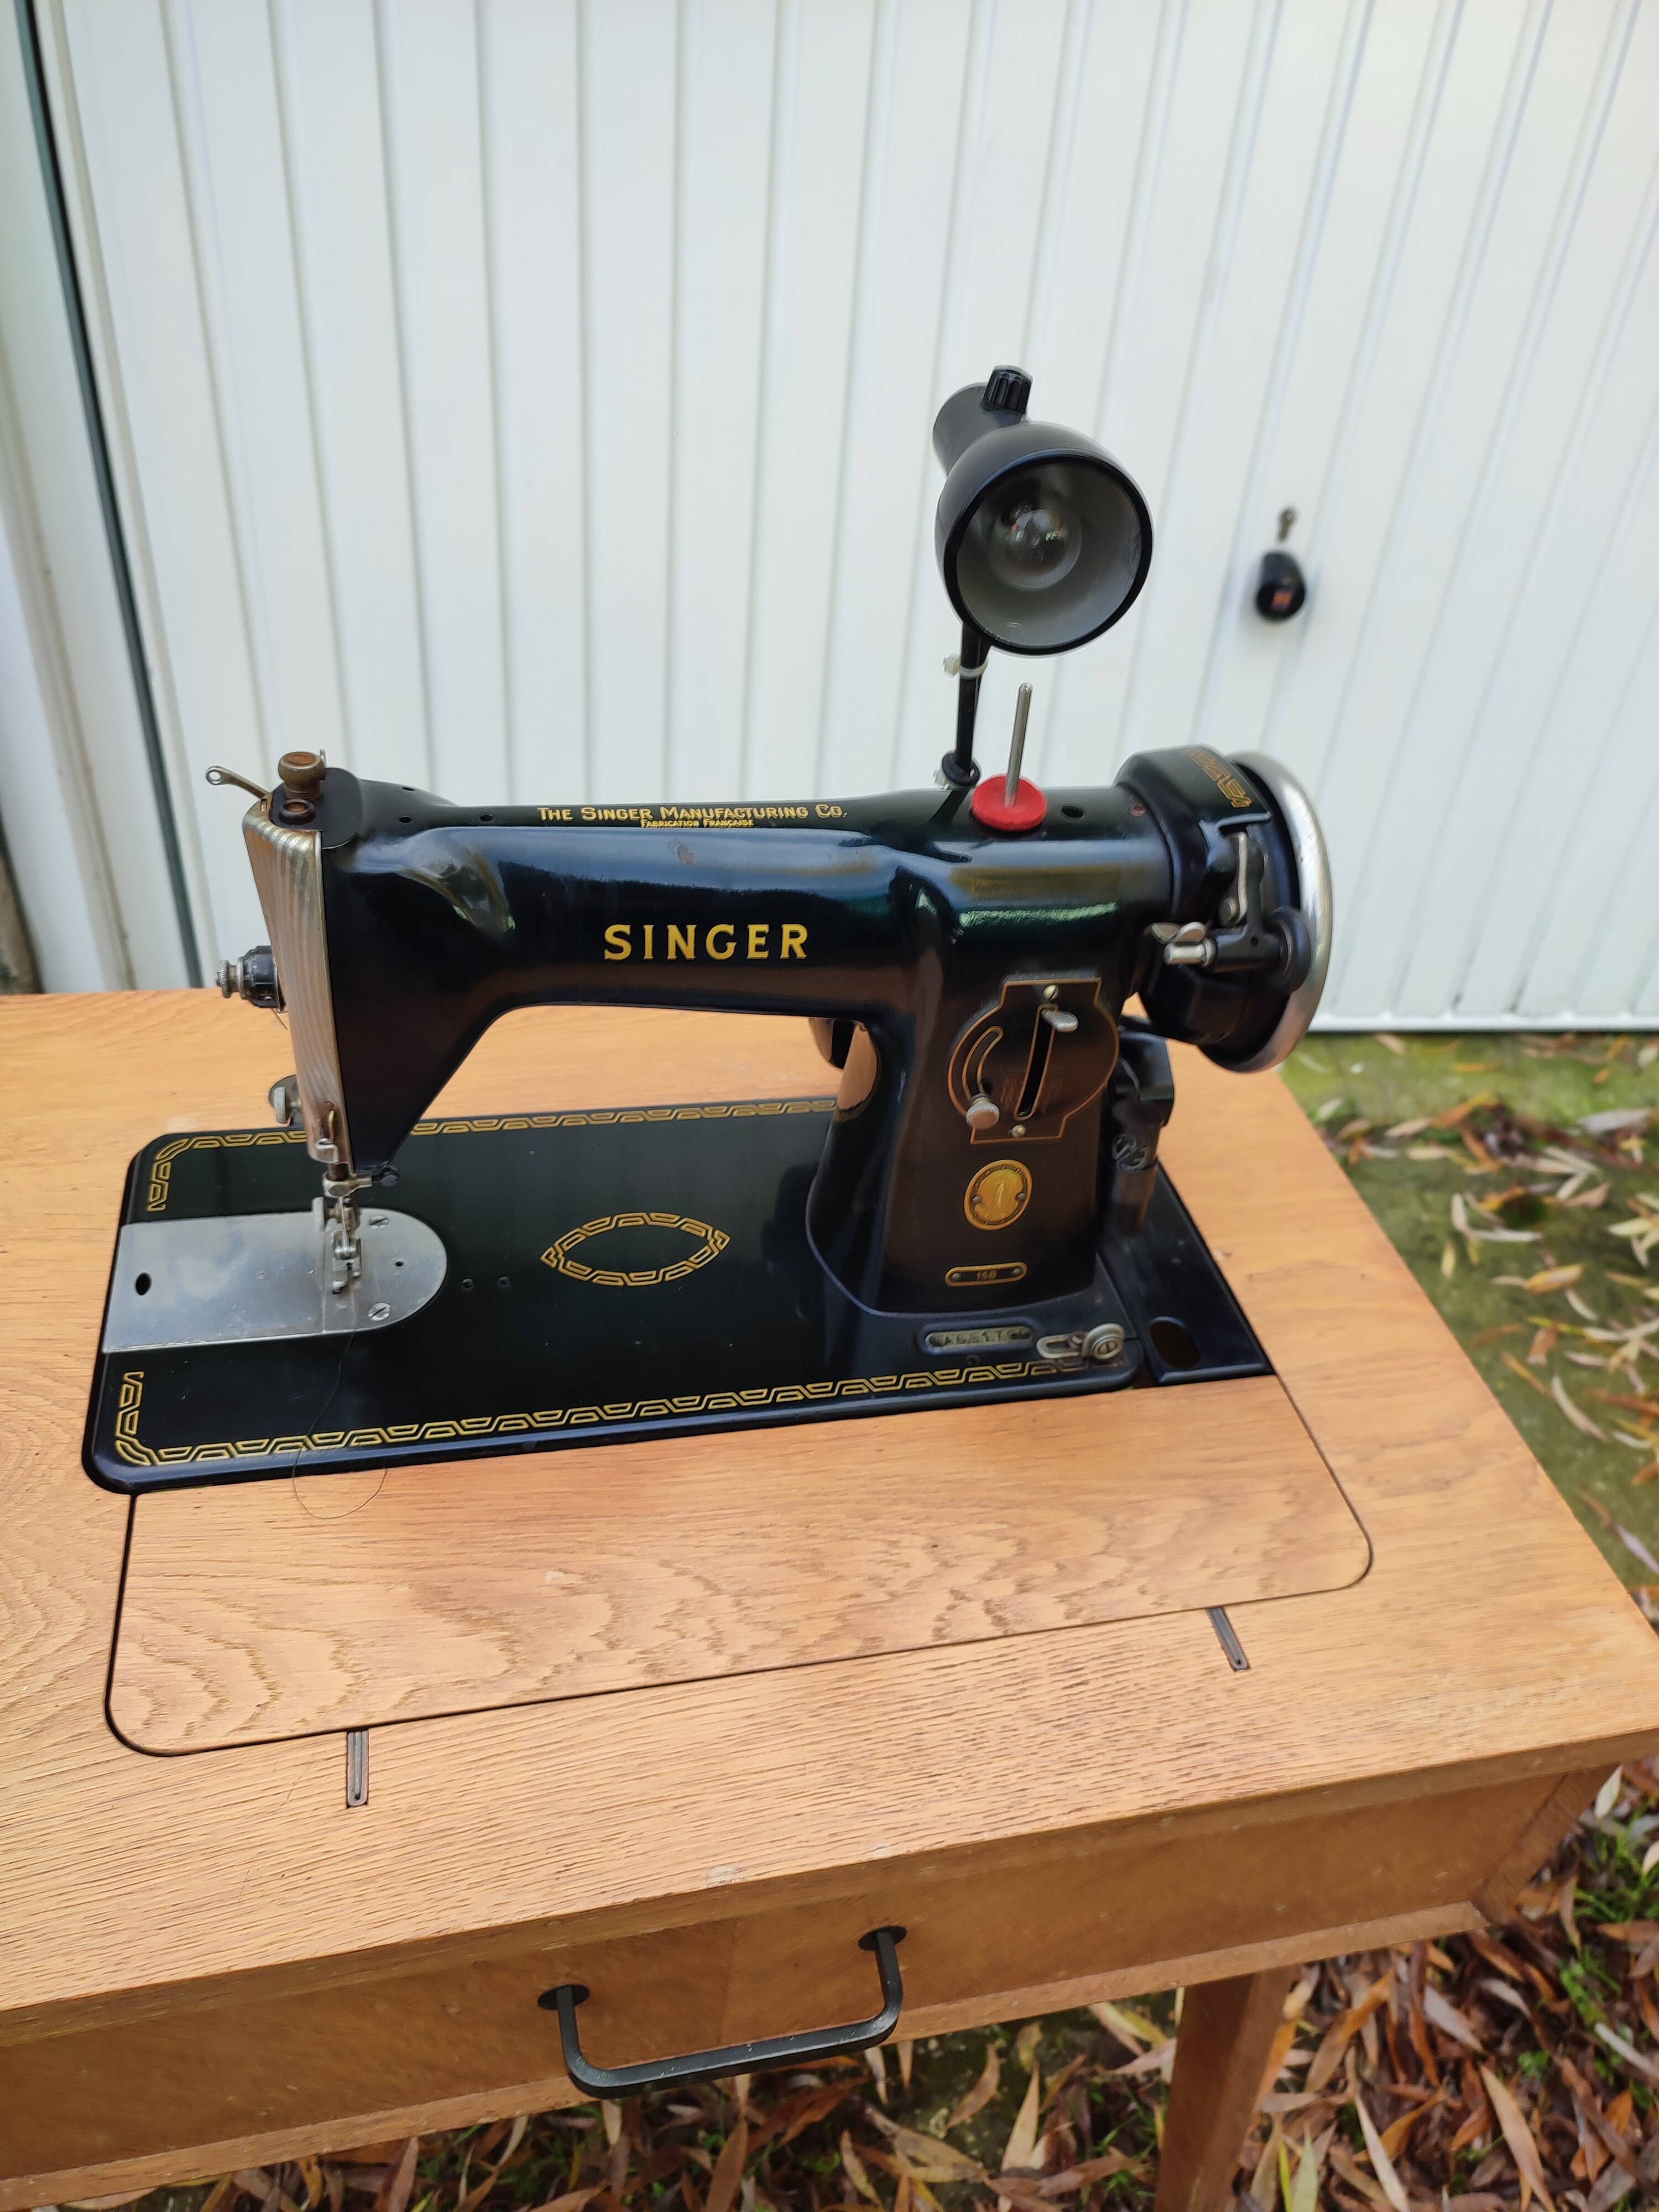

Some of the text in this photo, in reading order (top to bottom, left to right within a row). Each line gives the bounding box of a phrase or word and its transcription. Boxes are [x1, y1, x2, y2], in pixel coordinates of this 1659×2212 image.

[537, 808, 572, 821] THE
[581, 807, 653, 821] SINGER
[660, 806, 808, 820] MANUFACTURING
[604, 924, 808, 960] SINGER
